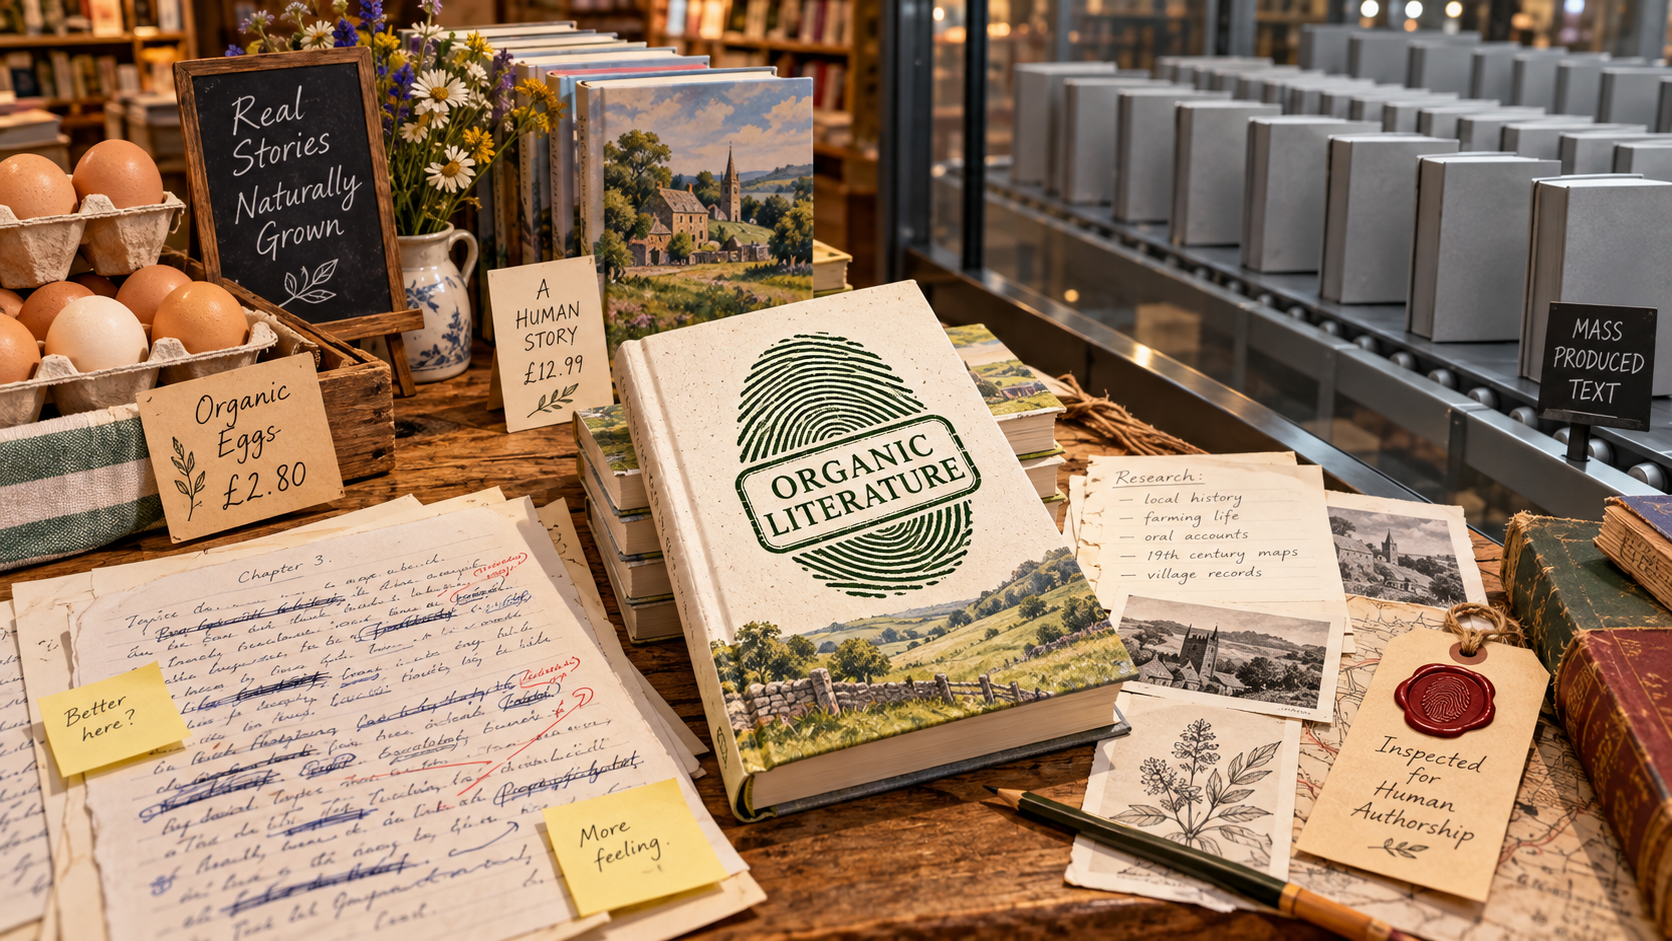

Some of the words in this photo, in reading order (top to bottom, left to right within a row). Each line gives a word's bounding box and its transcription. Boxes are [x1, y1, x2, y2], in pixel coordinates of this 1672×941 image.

[231, 84, 306, 136] Real
[232, 131, 330, 177] Stories
[235, 164, 363, 225] Naturally
[256, 219, 345, 261] Grown
[536, 278, 550, 300] A
[515, 300, 580, 330] HUMAN
[1571, 317, 1624, 342] MASS
[524, 325, 578, 352] STORY
[523, 354, 583, 386] £12.99
[1553, 345, 1645, 375] PRODUCED
[195, 381, 291, 428] Organic
[1568, 378, 1622, 404] TEXT
[771, 433, 934, 500] ORGANIC
[1115, 468, 1203, 486] Research:
[222, 461, 306, 511] £2.80
[763, 456, 966, 538] LITERATURE
[1144, 492, 1180, 505] local
[1190, 492, 1242, 508] history
[1144, 510, 1202, 528] farming
[1214, 508, 1240, 525] life
[1144, 529, 1174, 542] oral
[1184, 528, 1249, 541] accounts
[1147, 549, 1180, 561] 19th
[1189, 549, 1246, 565] century
[1258, 548, 1299, 562] maps
[237, 562, 304, 584] Chapter
[1147, 567, 1197, 585] village
[1208, 566, 1263, 579] records
[63, 695, 127, 728] Better
[1374, 735, 1488, 774] Inspected
[1405, 766, 1441, 785] for
[1373, 780, 1456, 813] Human
[580, 821, 631, 848] More
[1350, 801, 1475, 851] Authorship
